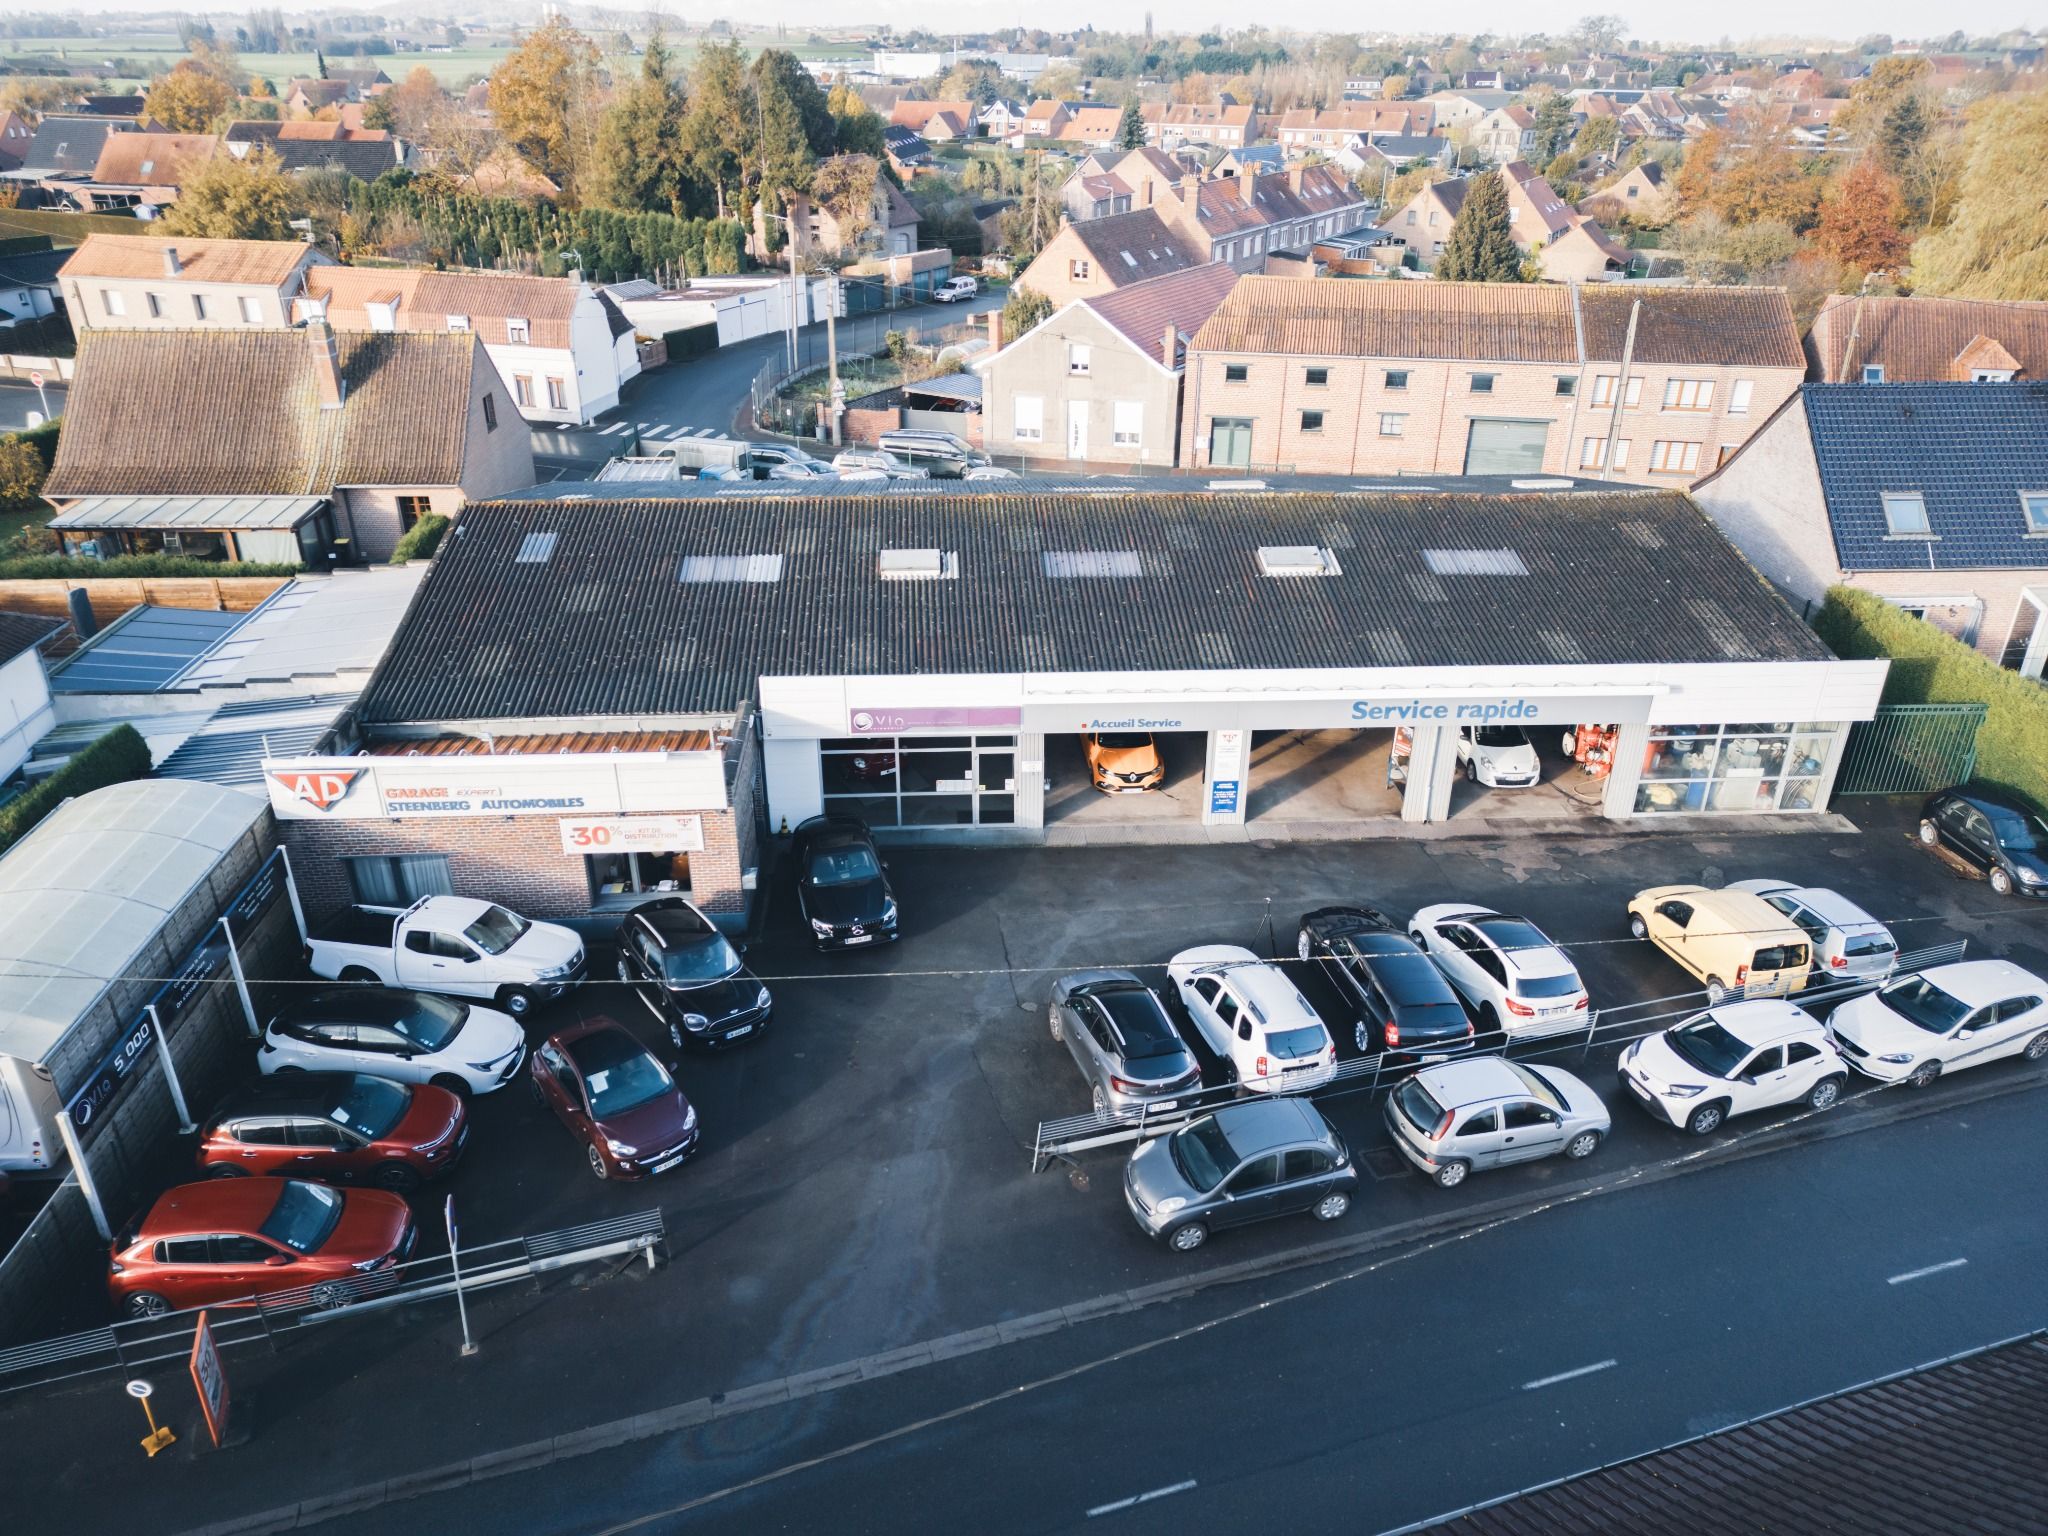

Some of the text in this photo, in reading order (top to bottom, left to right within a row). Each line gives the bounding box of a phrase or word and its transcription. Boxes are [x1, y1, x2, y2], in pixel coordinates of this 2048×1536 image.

[1351, 699, 1538, 723] Service rapide
[1090, 718, 1182, 728] Accueil Service
[293, 775, 347, 801] AD
[385, 788, 448, 798] GARAGE
[388, 797, 585, 812] STEENBERG AUTOMOBILES
[114, 1054, 124, 1072] 5
[125, 1023, 149, 1057] 000
